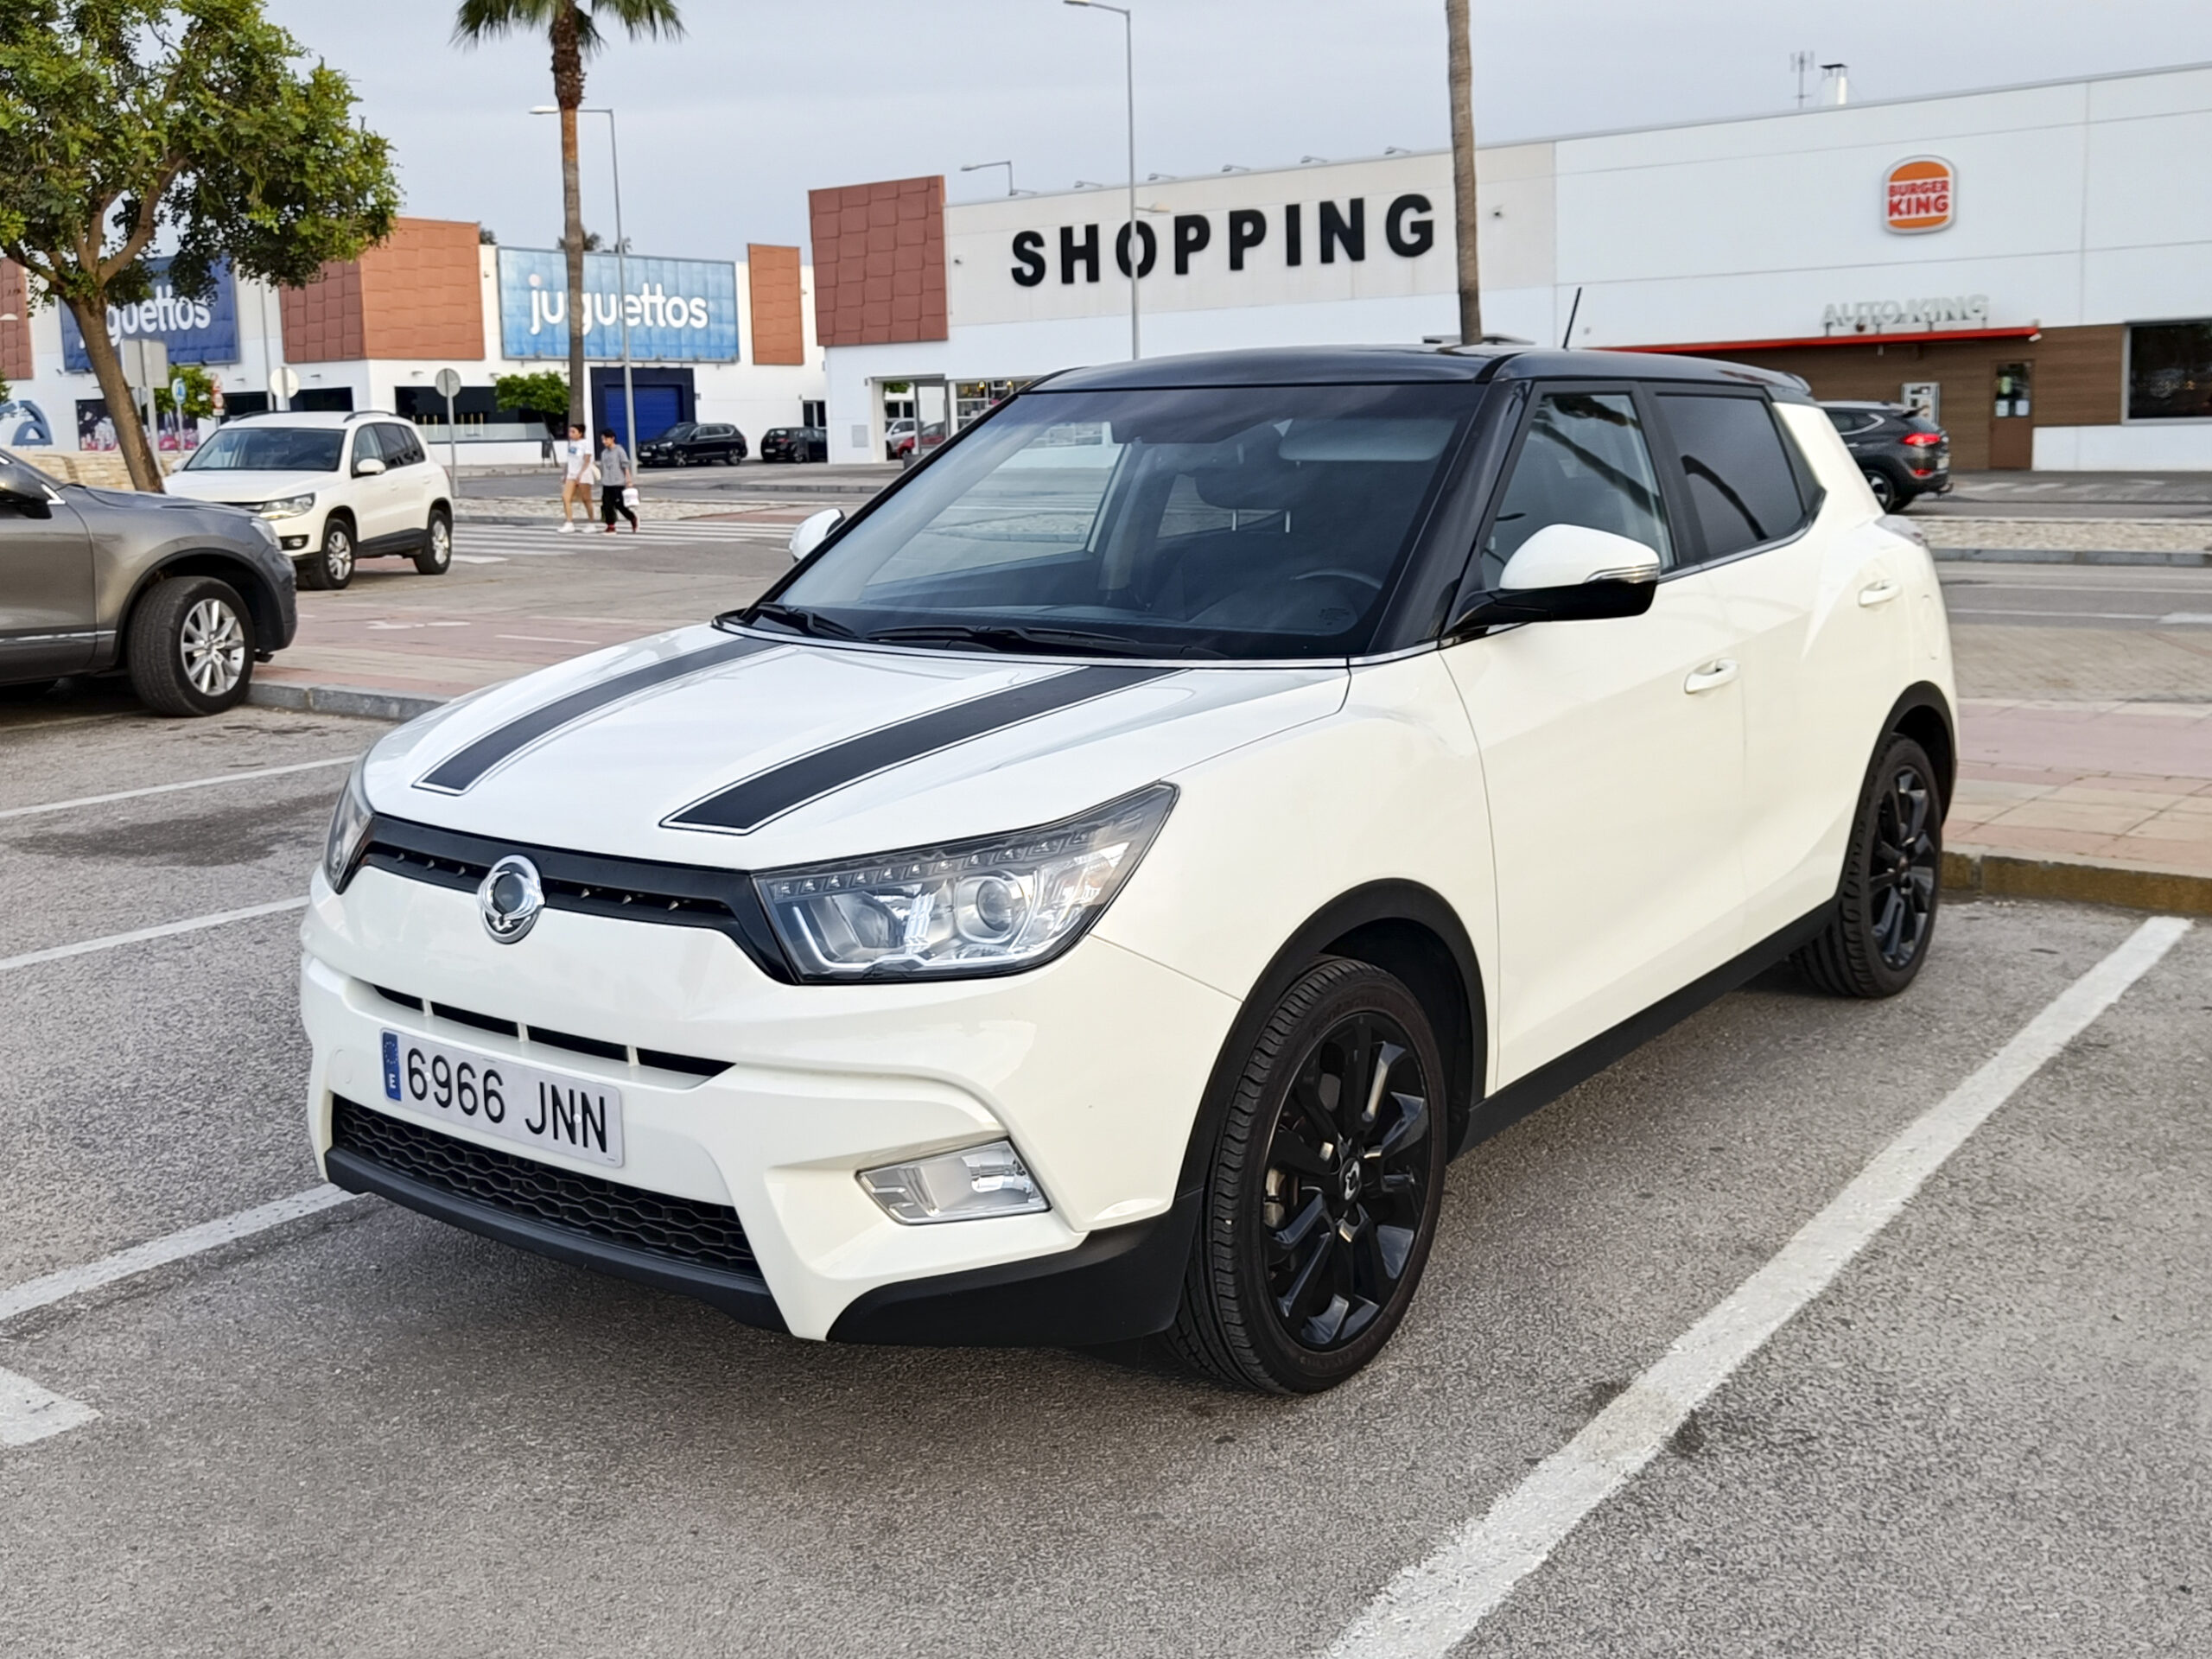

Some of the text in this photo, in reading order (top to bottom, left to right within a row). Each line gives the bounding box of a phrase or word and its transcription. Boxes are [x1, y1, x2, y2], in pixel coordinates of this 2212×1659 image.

[1888, 180, 1948, 198] BURGER
[1888, 194, 1948, 217] KING
[1011, 193, 1434, 288] SHOPPING
[79, 284, 212, 349] guettos
[388, 1047, 607, 1154] E 6966 JNN
